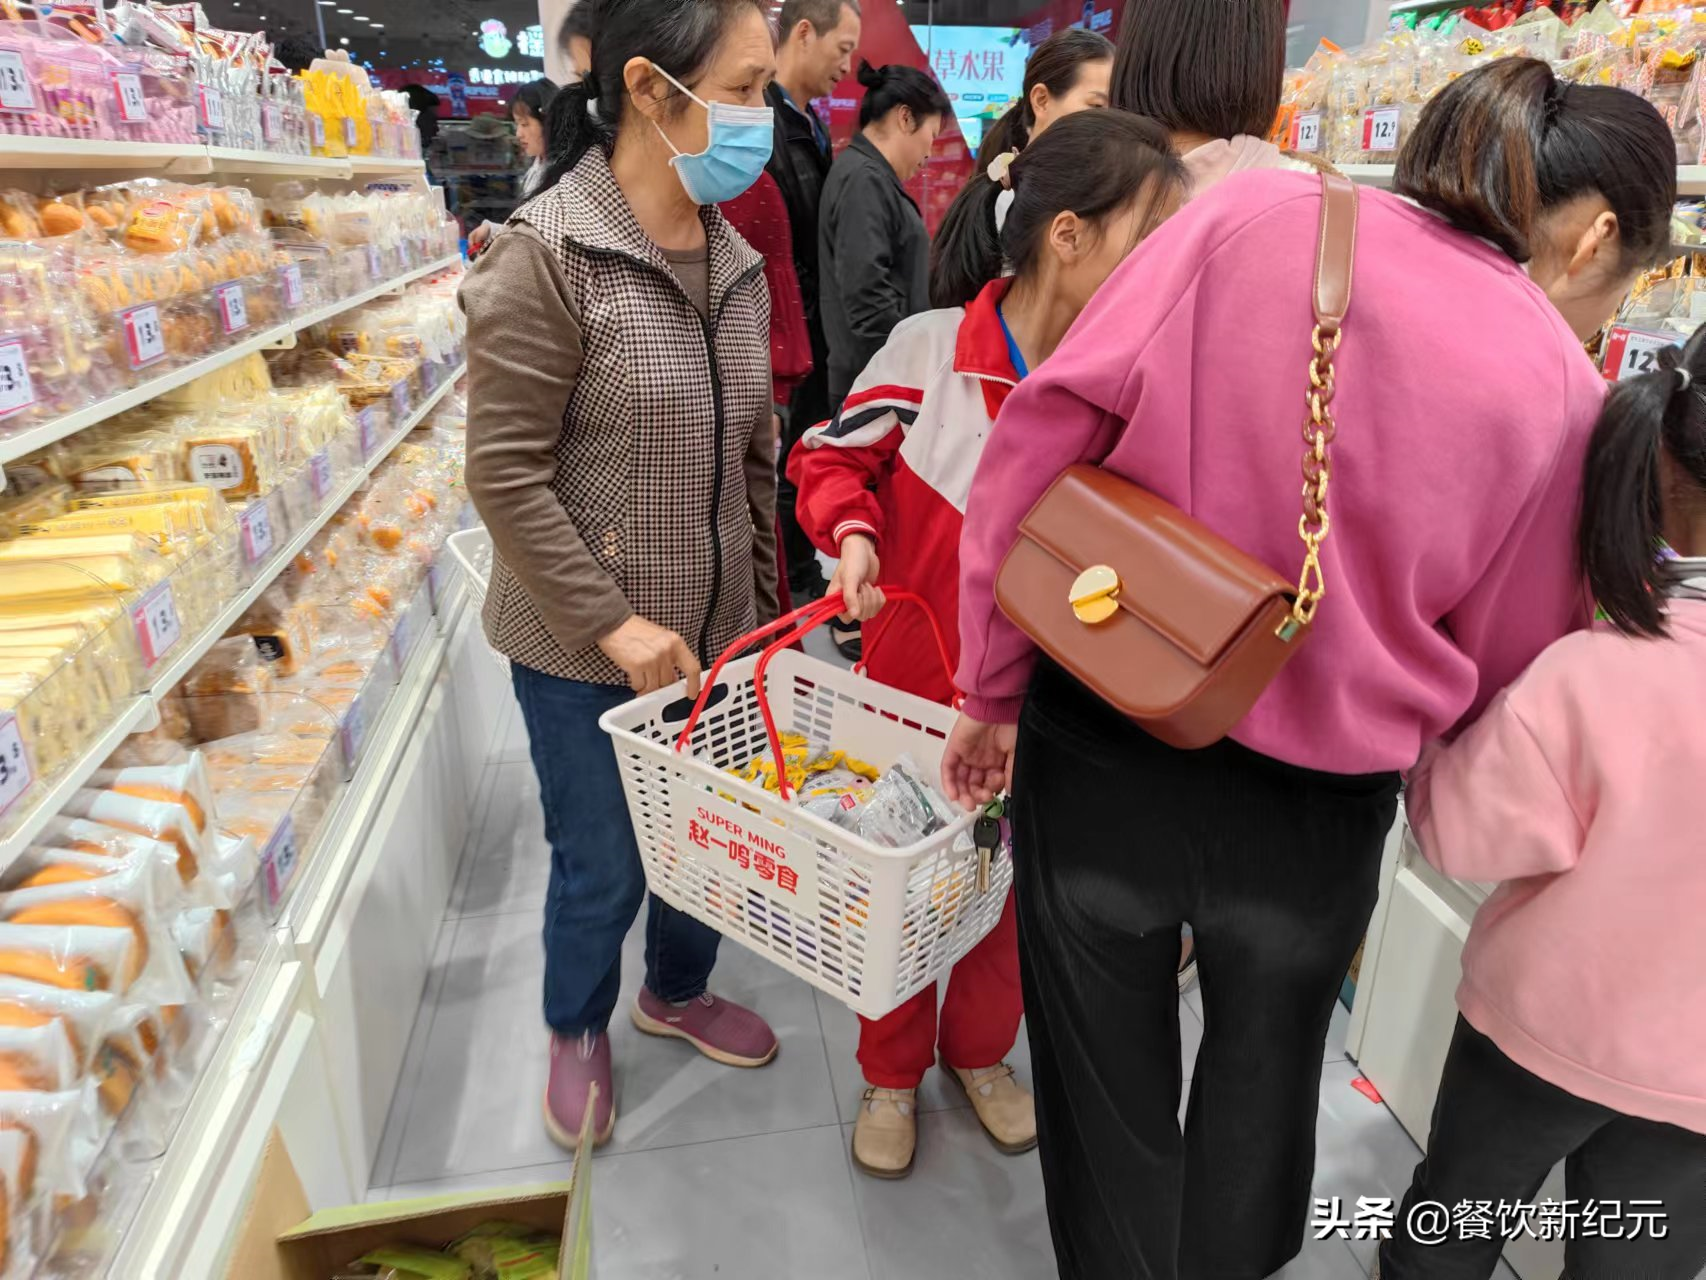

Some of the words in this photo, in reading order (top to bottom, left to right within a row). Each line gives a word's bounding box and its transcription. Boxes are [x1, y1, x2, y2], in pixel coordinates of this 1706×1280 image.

[926, 48, 1005, 82] 草水果
[1376, 121, 1396, 138] 12.9
[696, 806, 743, 839] SUPER
[747, 830, 787, 860] MING
[688, 818, 800, 897] 赵一鸣零食
